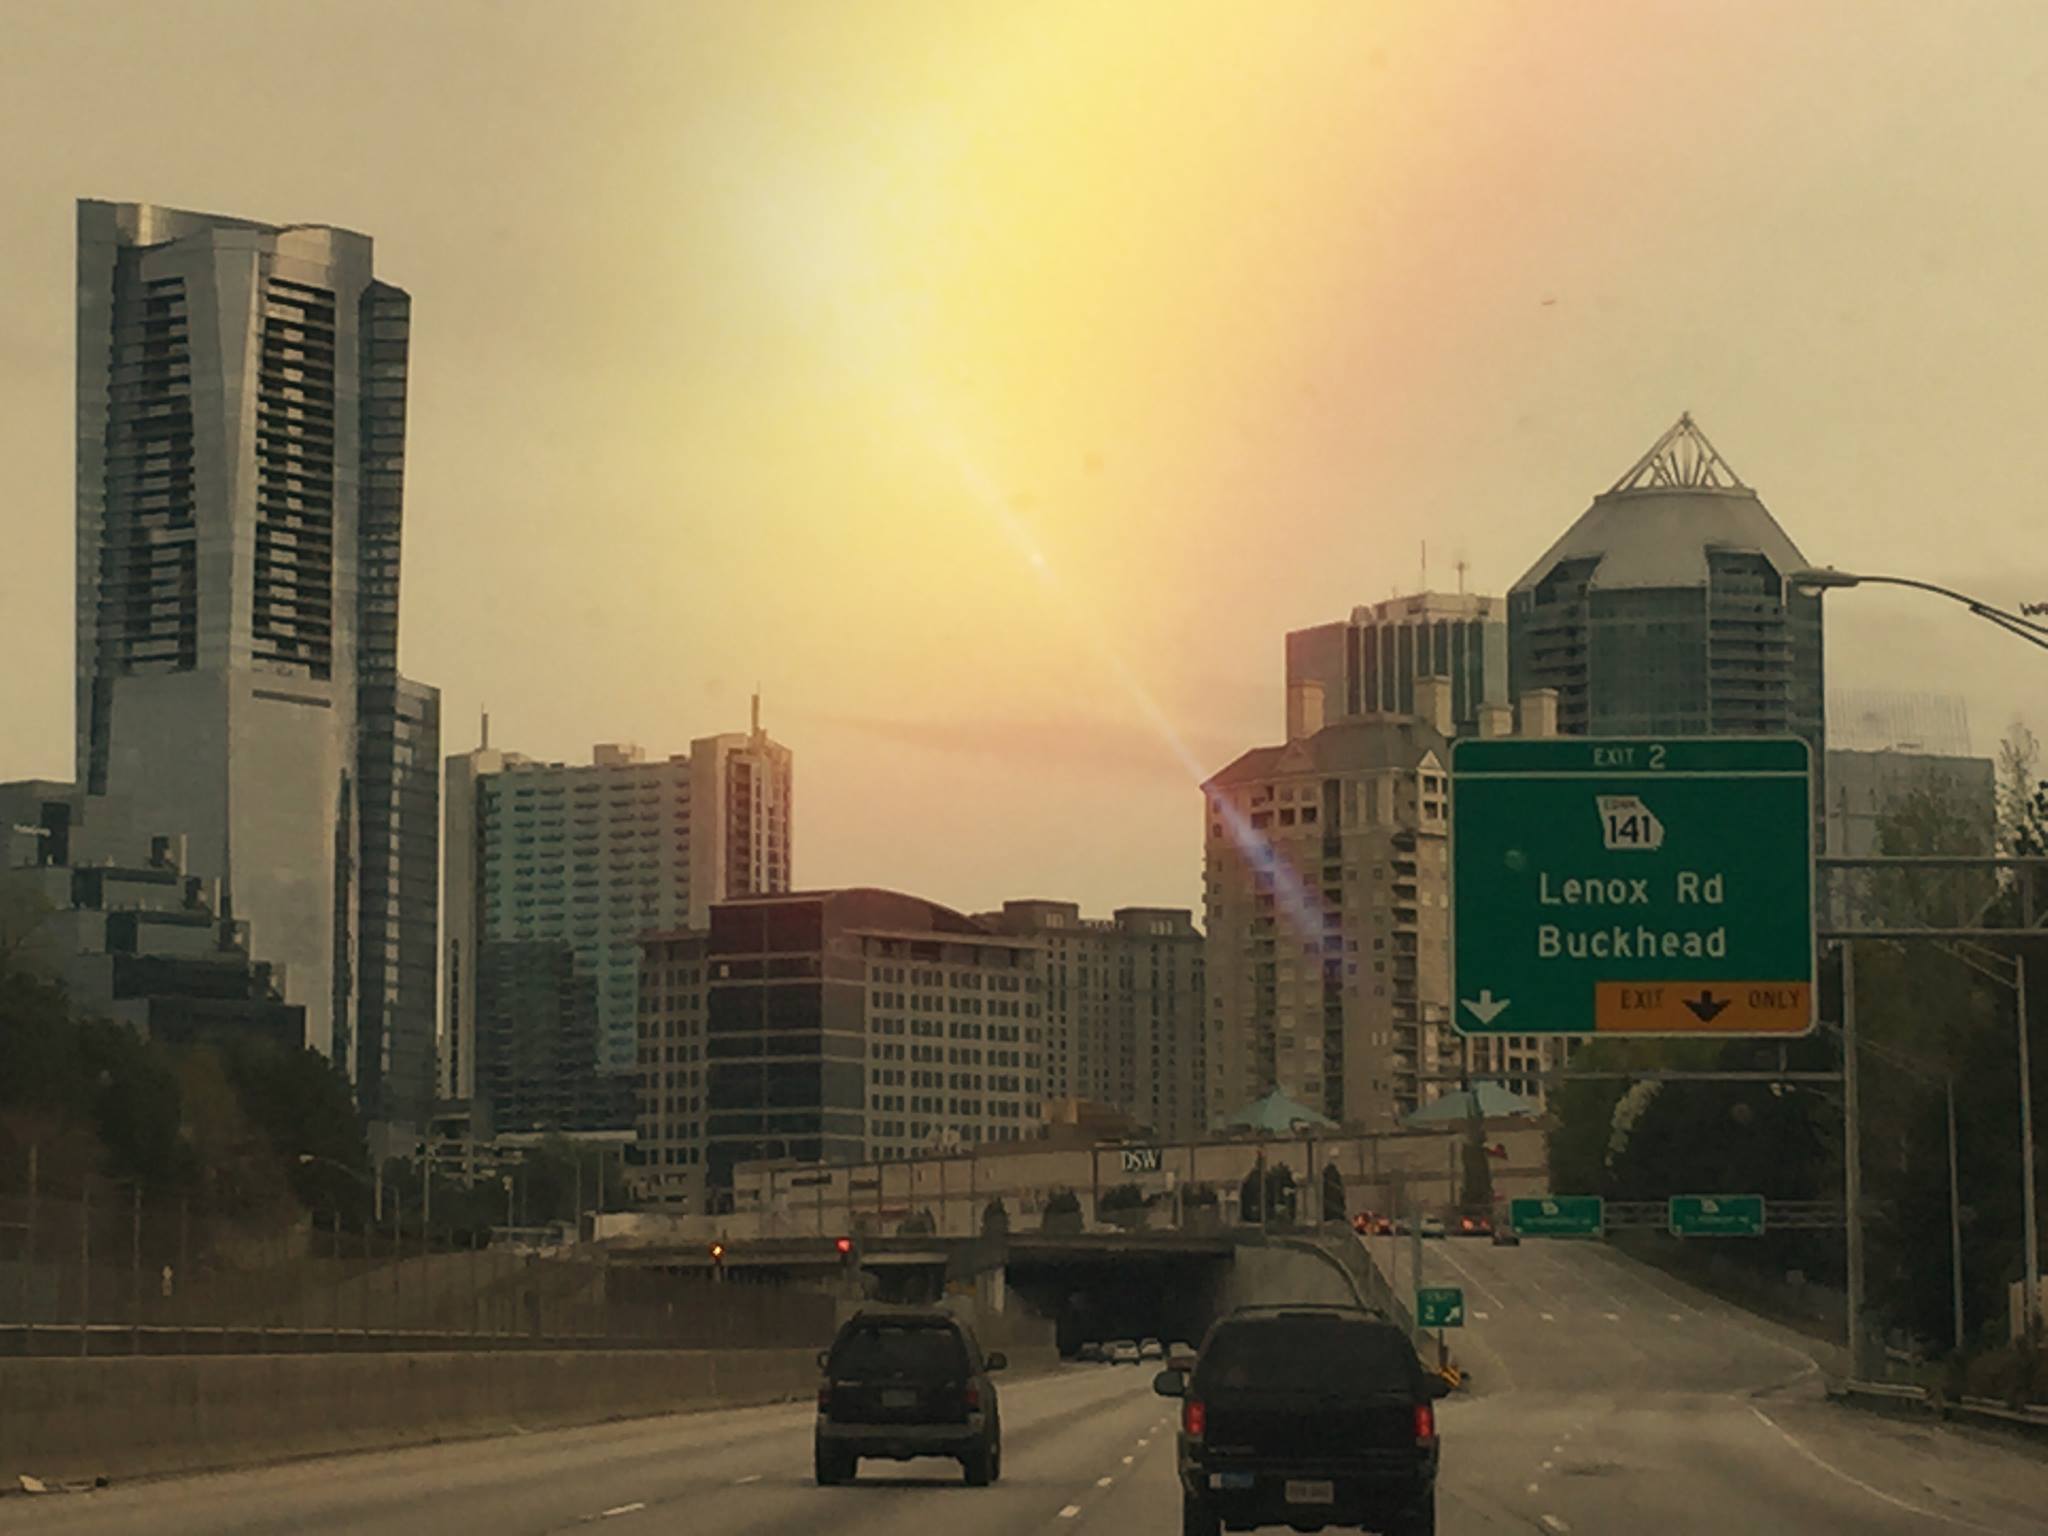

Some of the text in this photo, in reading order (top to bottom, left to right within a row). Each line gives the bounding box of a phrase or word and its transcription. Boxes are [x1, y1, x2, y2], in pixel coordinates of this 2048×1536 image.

[1593, 745, 1666, 769] EXIT 2
[1608, 815, 1651, 843] 141
[1540, 871, 1724, 904] Lenox Rd
[1538, 925, 1727, 958] Buckhead
[1621, 990, 1800, 1010] EXIT ONLY
[1120, 1149, 1158, 1170] DSW
